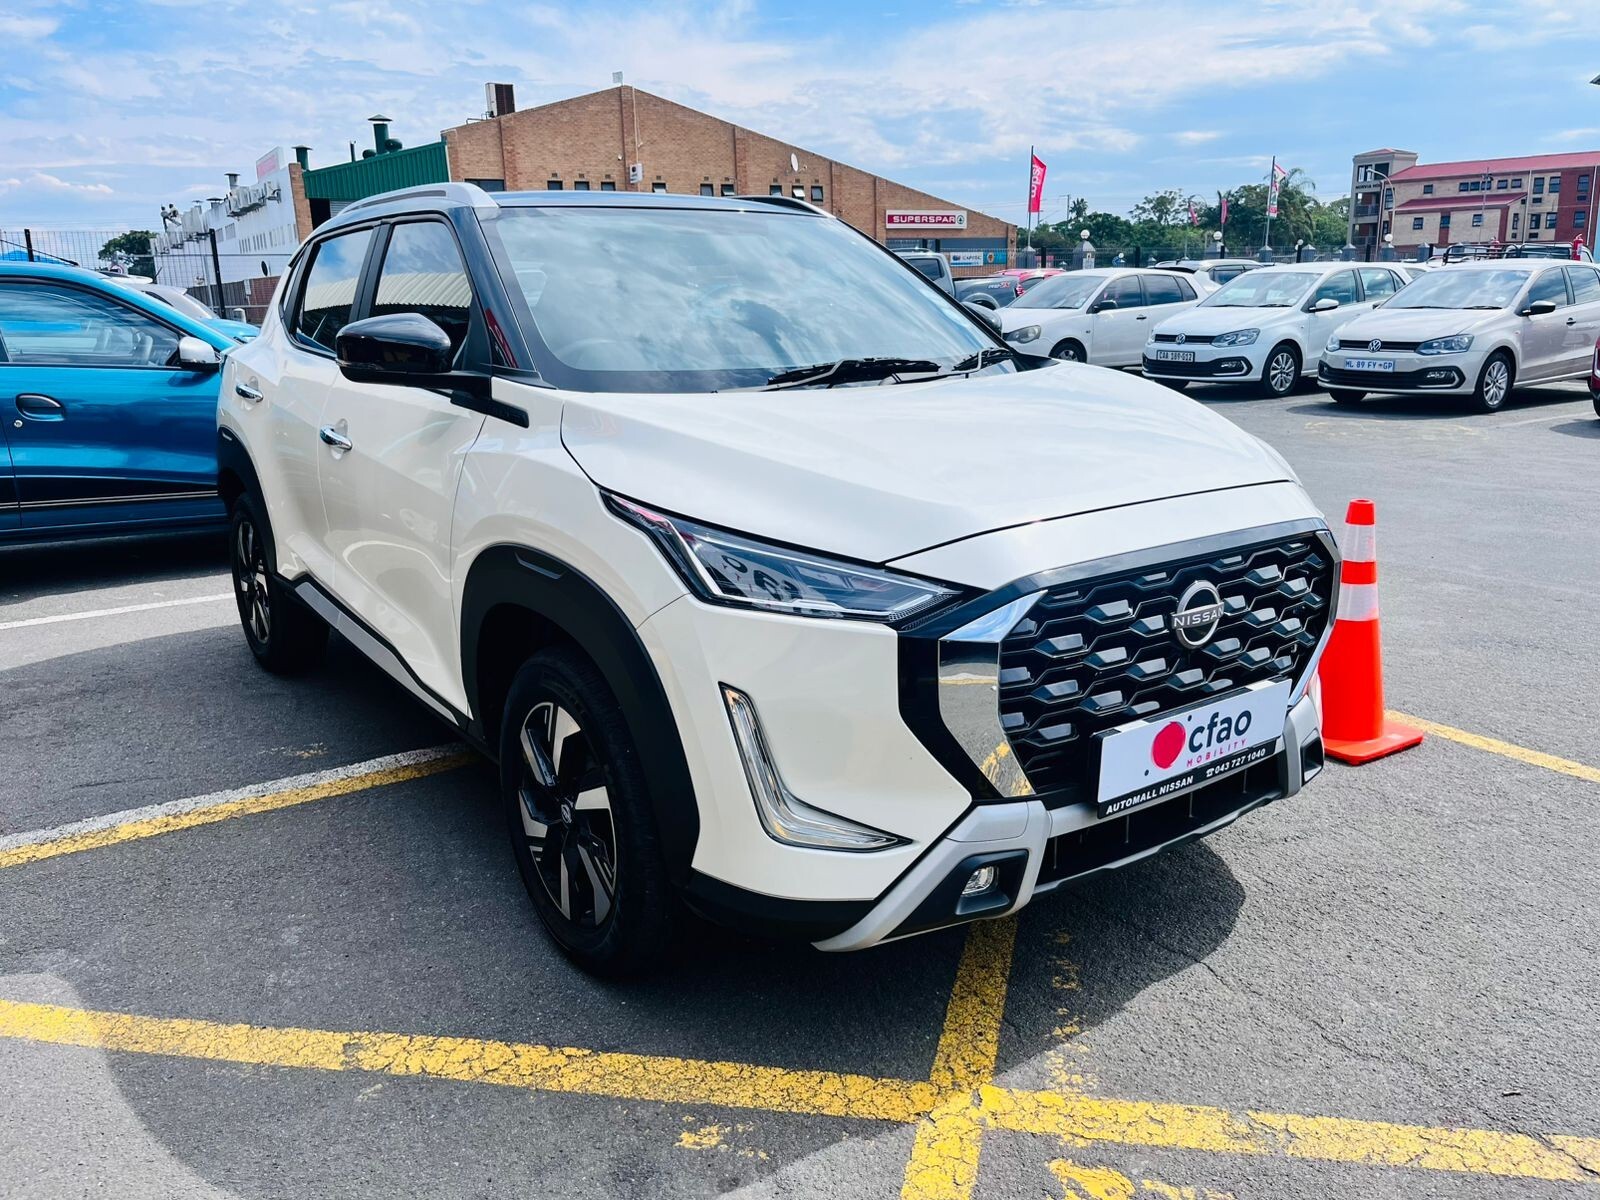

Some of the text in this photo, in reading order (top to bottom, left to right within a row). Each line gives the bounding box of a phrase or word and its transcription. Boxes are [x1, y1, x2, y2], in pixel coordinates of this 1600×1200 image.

[893, 215, 956, 223] SUPERSPAR
[1367, 361, 1377, 369] FY
[1383, 362, 1393, 370] GP
[1173, 606, 1224, 627] NISSAN
[1188, 710, 1252, 753] cfao
[1186, 738, 1247, 767] MOBILITY
[1105, 748, 1266, 815] AUTOMALL NISSAN 043 727 1040
